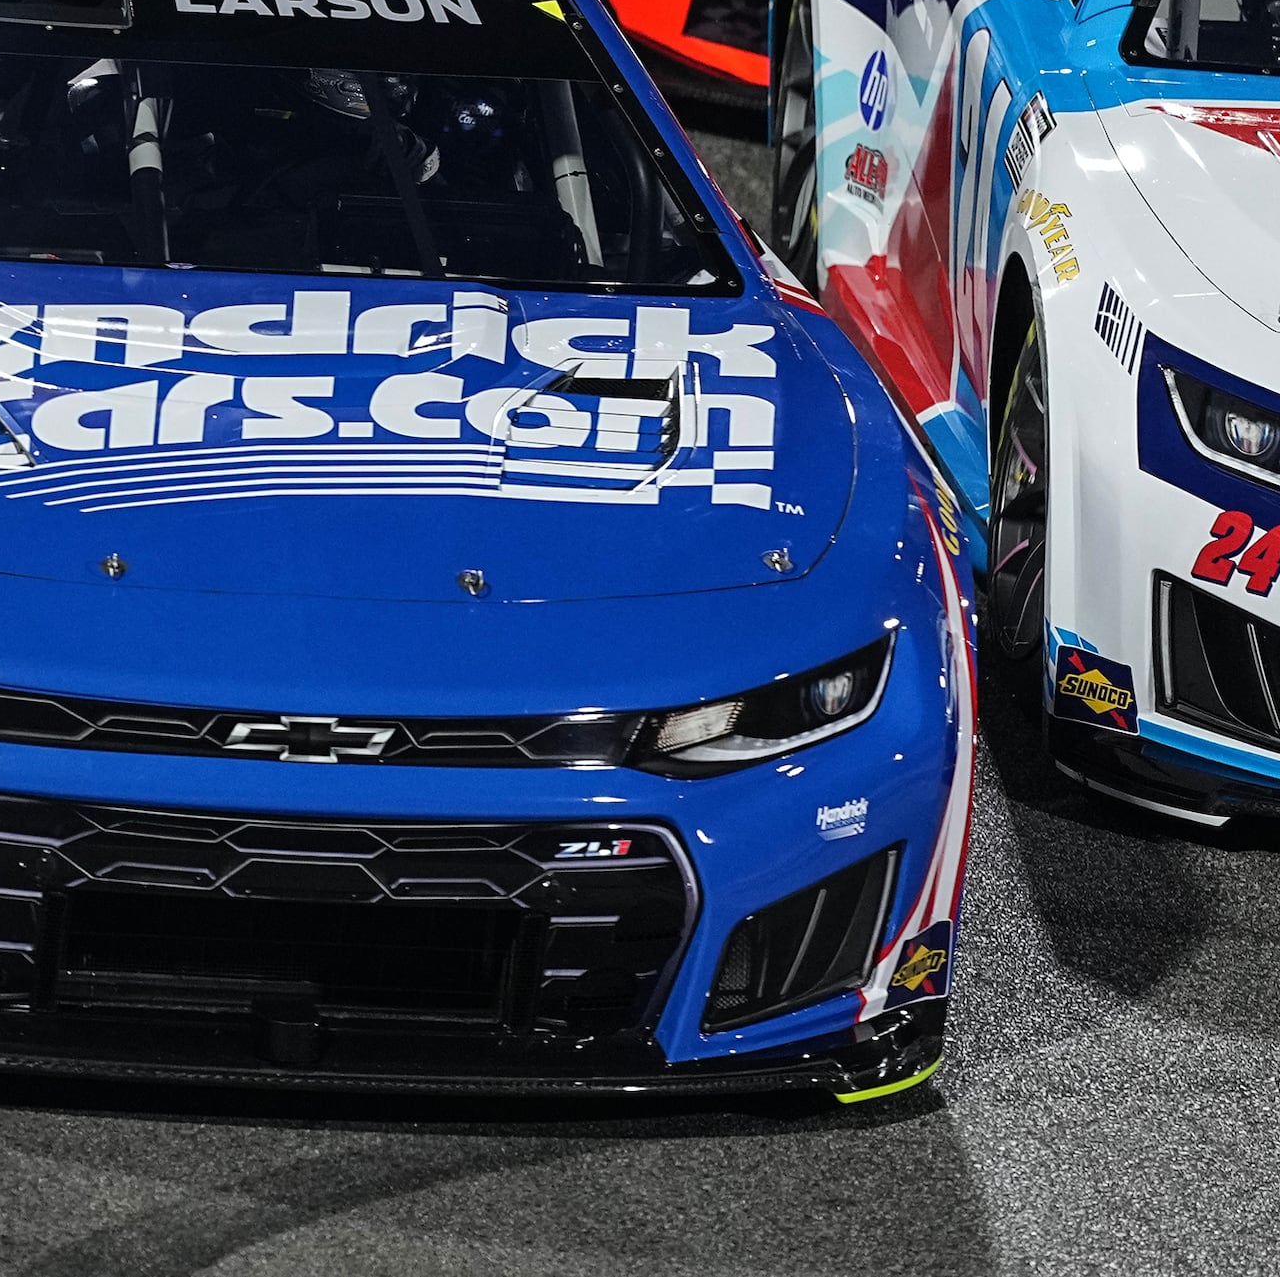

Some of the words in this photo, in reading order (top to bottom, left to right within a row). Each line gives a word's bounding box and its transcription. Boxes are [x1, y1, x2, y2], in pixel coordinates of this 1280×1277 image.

[861, 51, 889, 131] hp
[775, 501, 806, 516] TM
[1060, 674, 1134, 710] SUNOCO
[816, 797, 869, 826] Hendrick
[554, 839, 633, 859] ZL1
